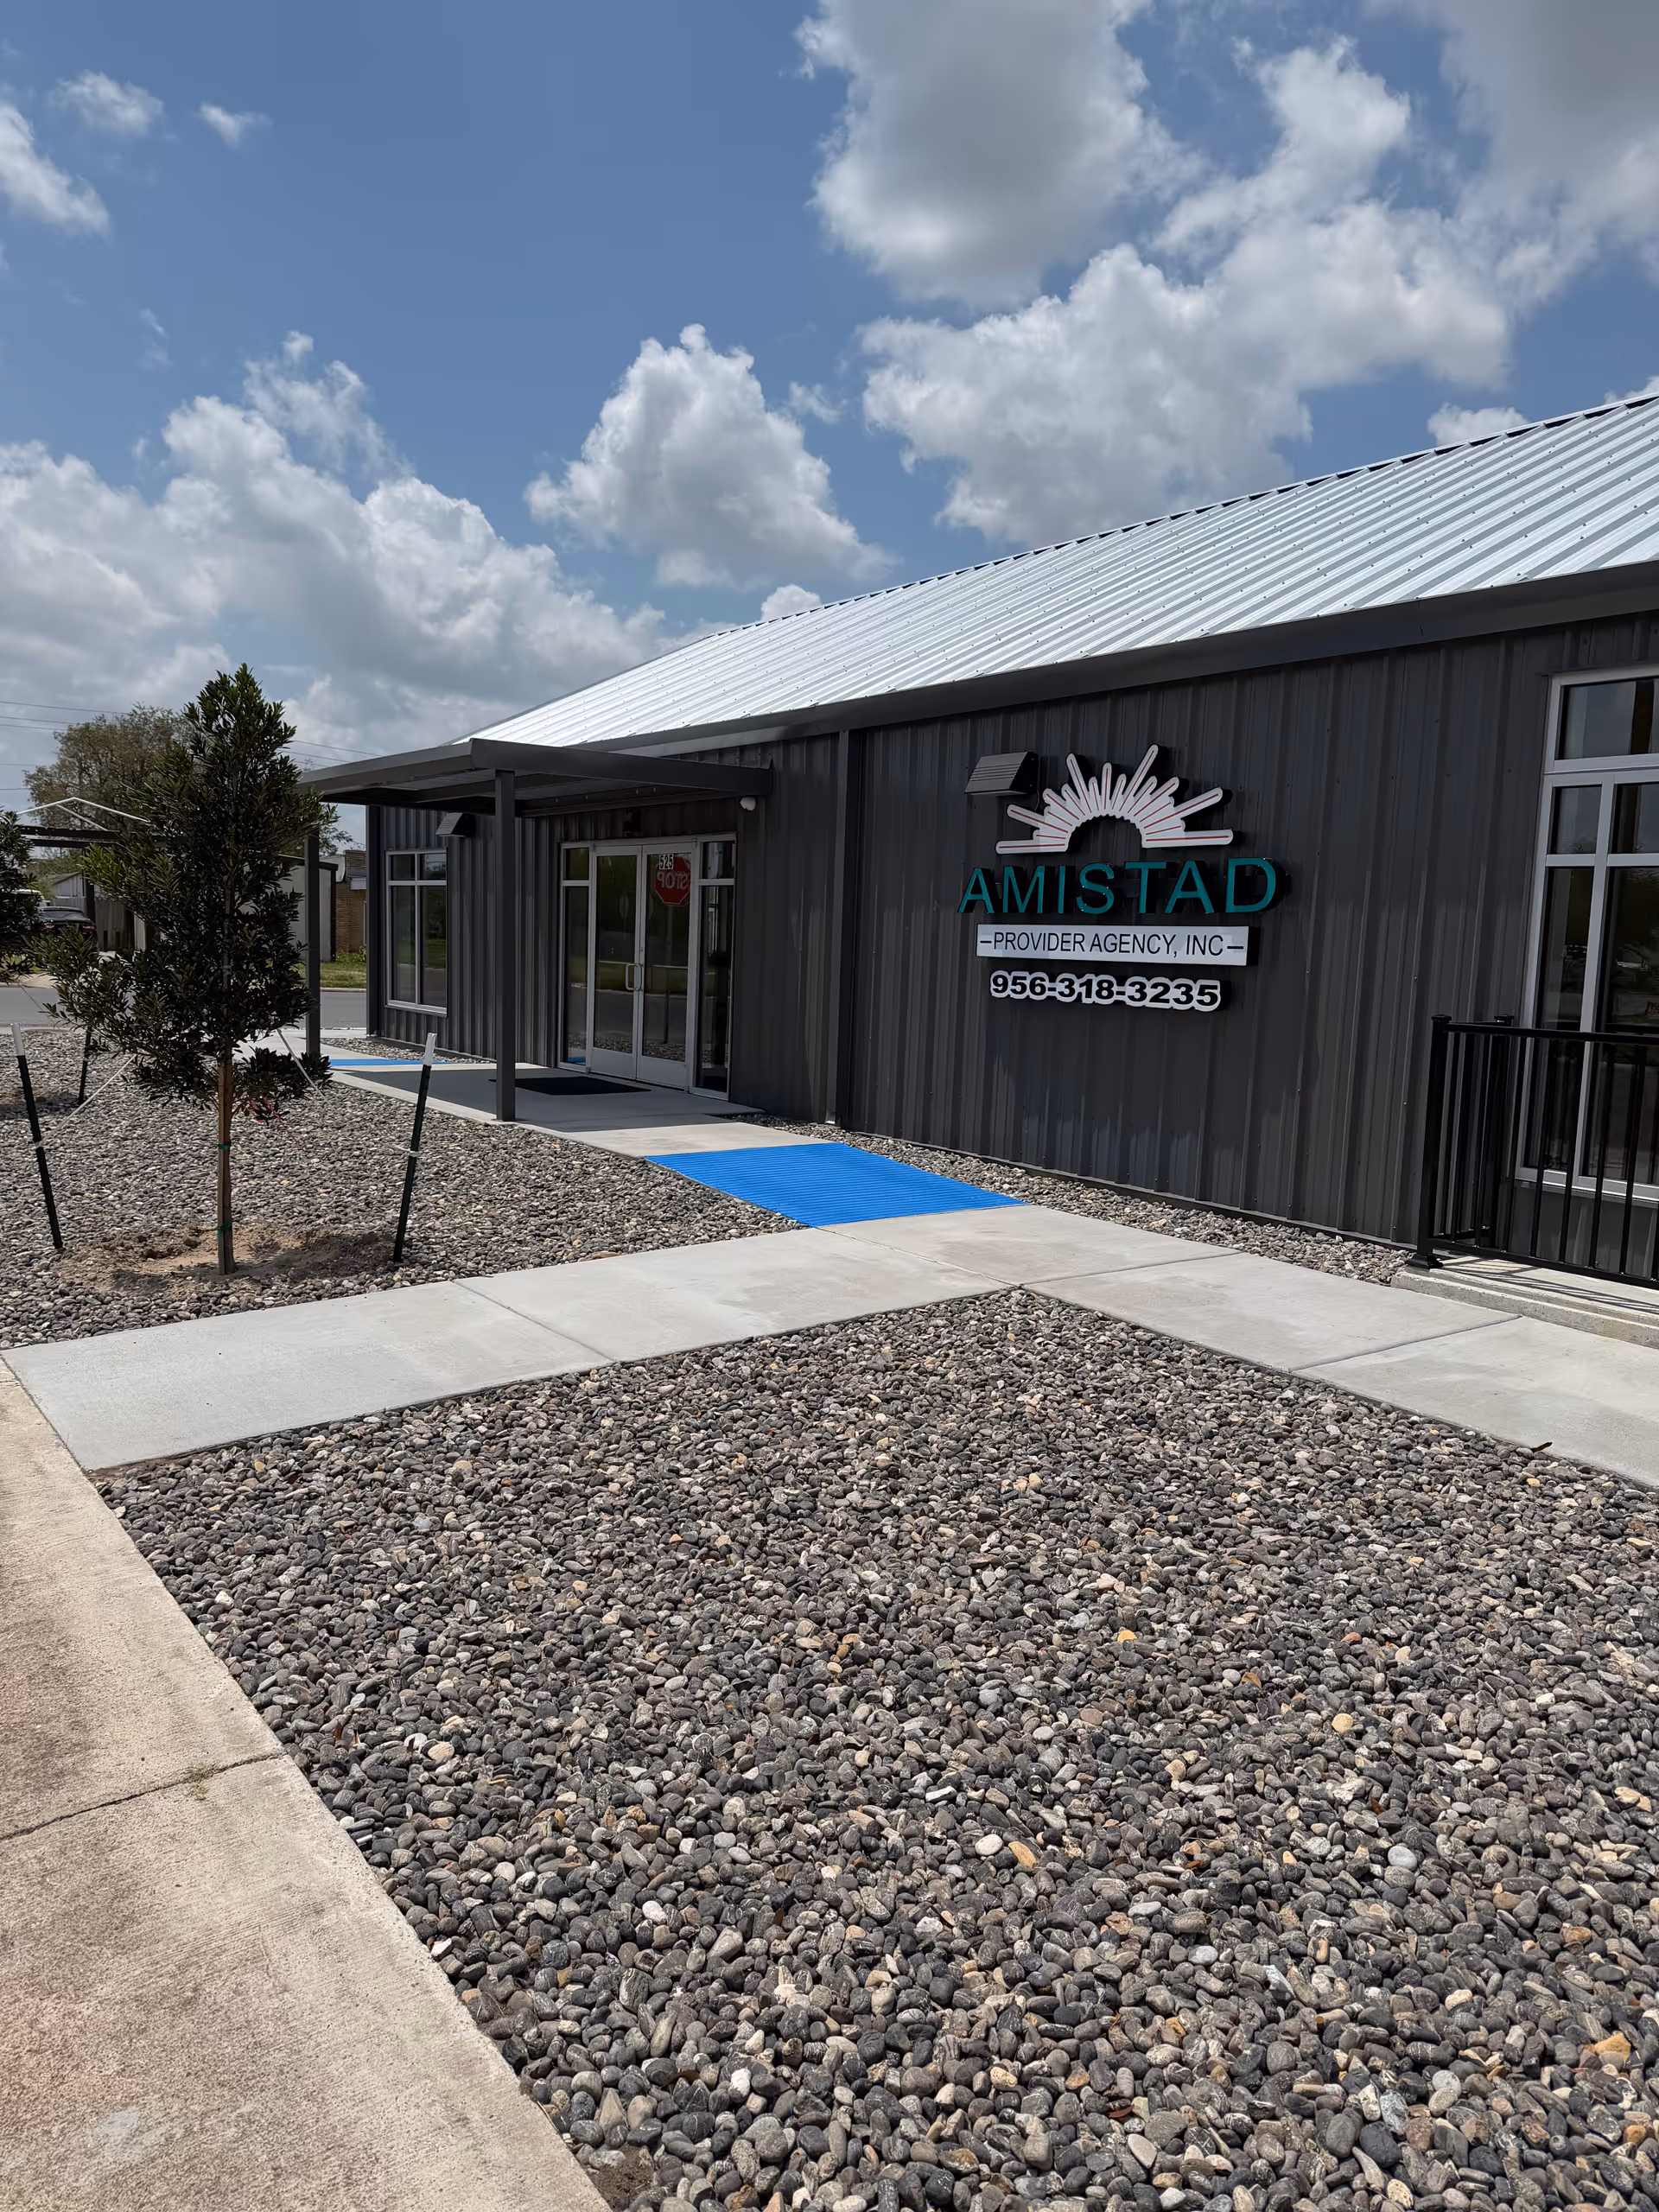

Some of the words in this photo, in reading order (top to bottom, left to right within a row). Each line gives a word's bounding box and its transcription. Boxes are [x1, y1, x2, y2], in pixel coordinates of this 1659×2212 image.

[659, 855, 673, 869] 525
[958, 858, 1276, 914] AMISTAD
[994, 931, 1085, 952] PROVIDER
[1090, 933, 1177, 958] AGENCY,
[992, 974, 1218, 1007] 956-318-3235
